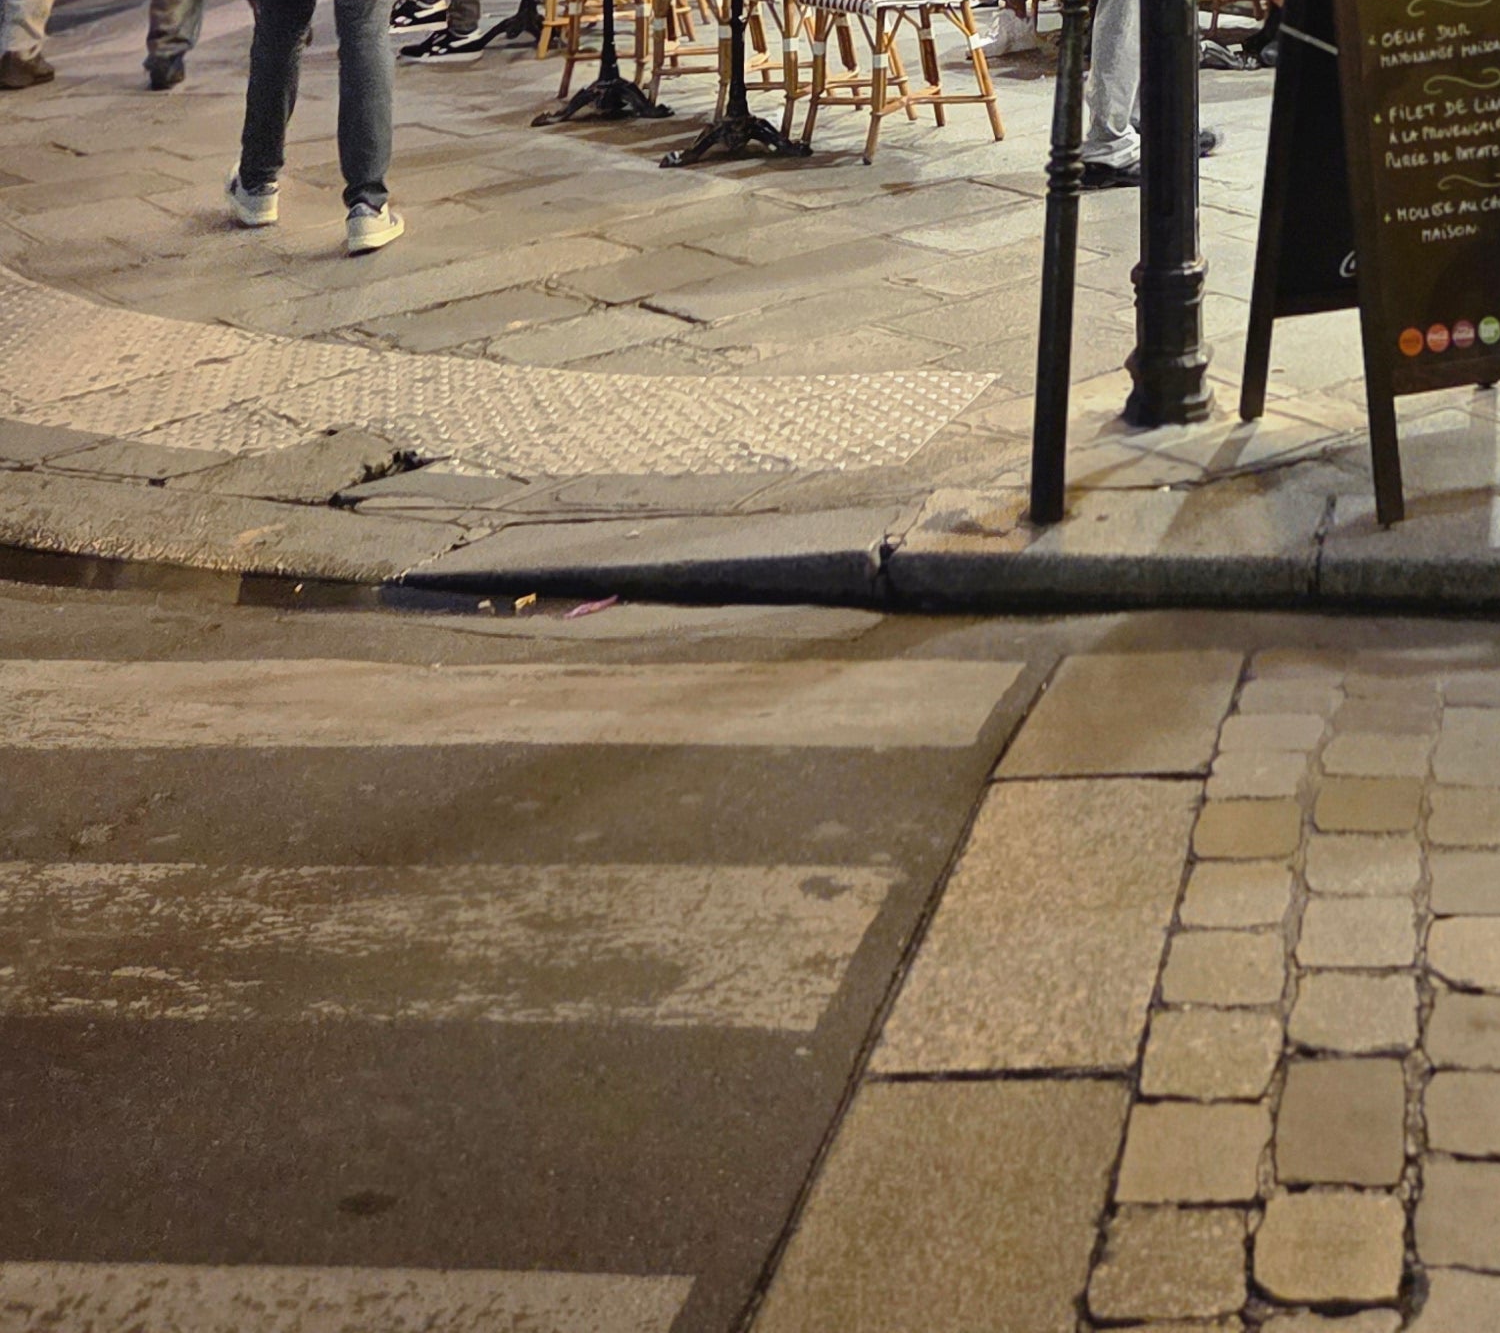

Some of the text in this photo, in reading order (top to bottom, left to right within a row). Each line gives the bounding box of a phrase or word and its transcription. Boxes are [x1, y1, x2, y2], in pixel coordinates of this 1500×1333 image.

[1443, 98, 1468, 118] DE
[1433, 151, 1453, 164] DE
[1458, 199, 1479, 215] AU
